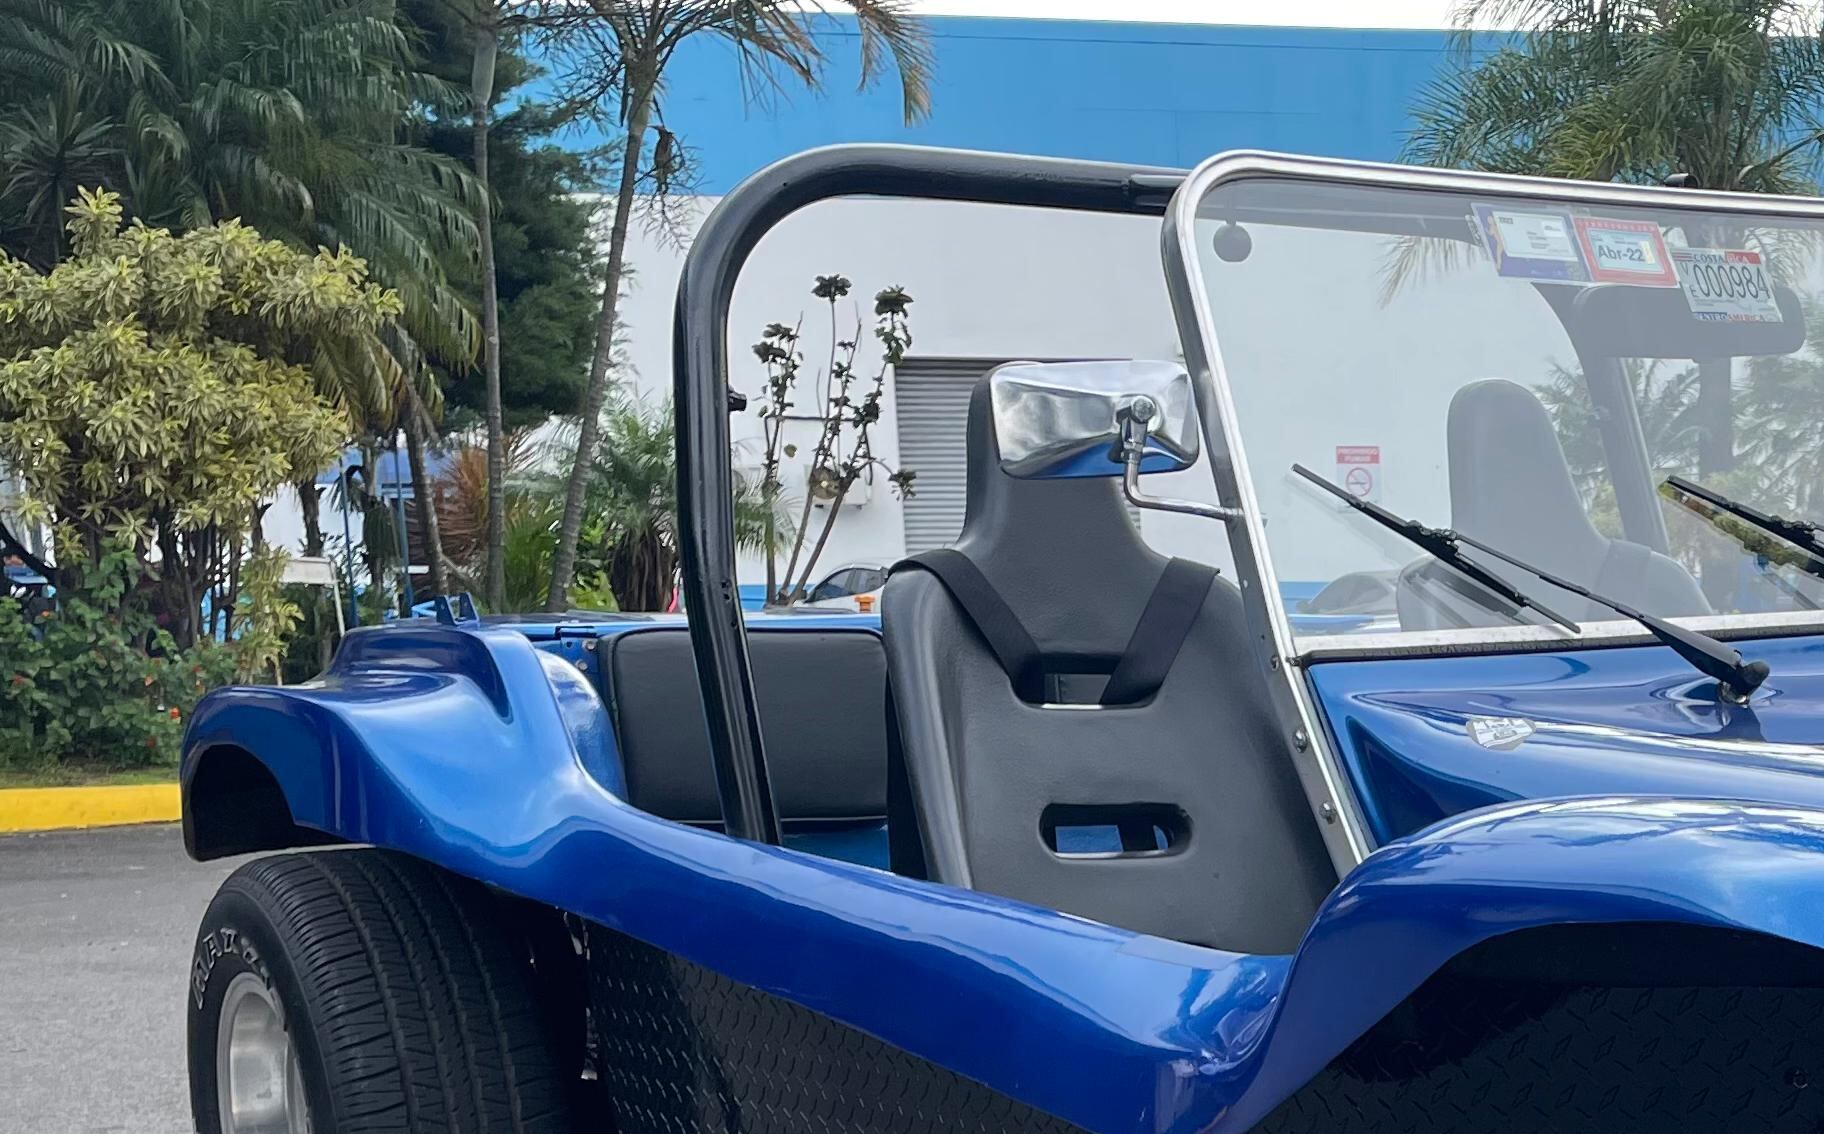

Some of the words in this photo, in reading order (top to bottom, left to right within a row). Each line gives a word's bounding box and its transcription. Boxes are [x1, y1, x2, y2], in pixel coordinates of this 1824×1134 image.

[1598, 245, 1646, 262] Abr-22
[1695, 253, 1725, 264] COSTA
[1693, 264, 1771, 299] 000984
